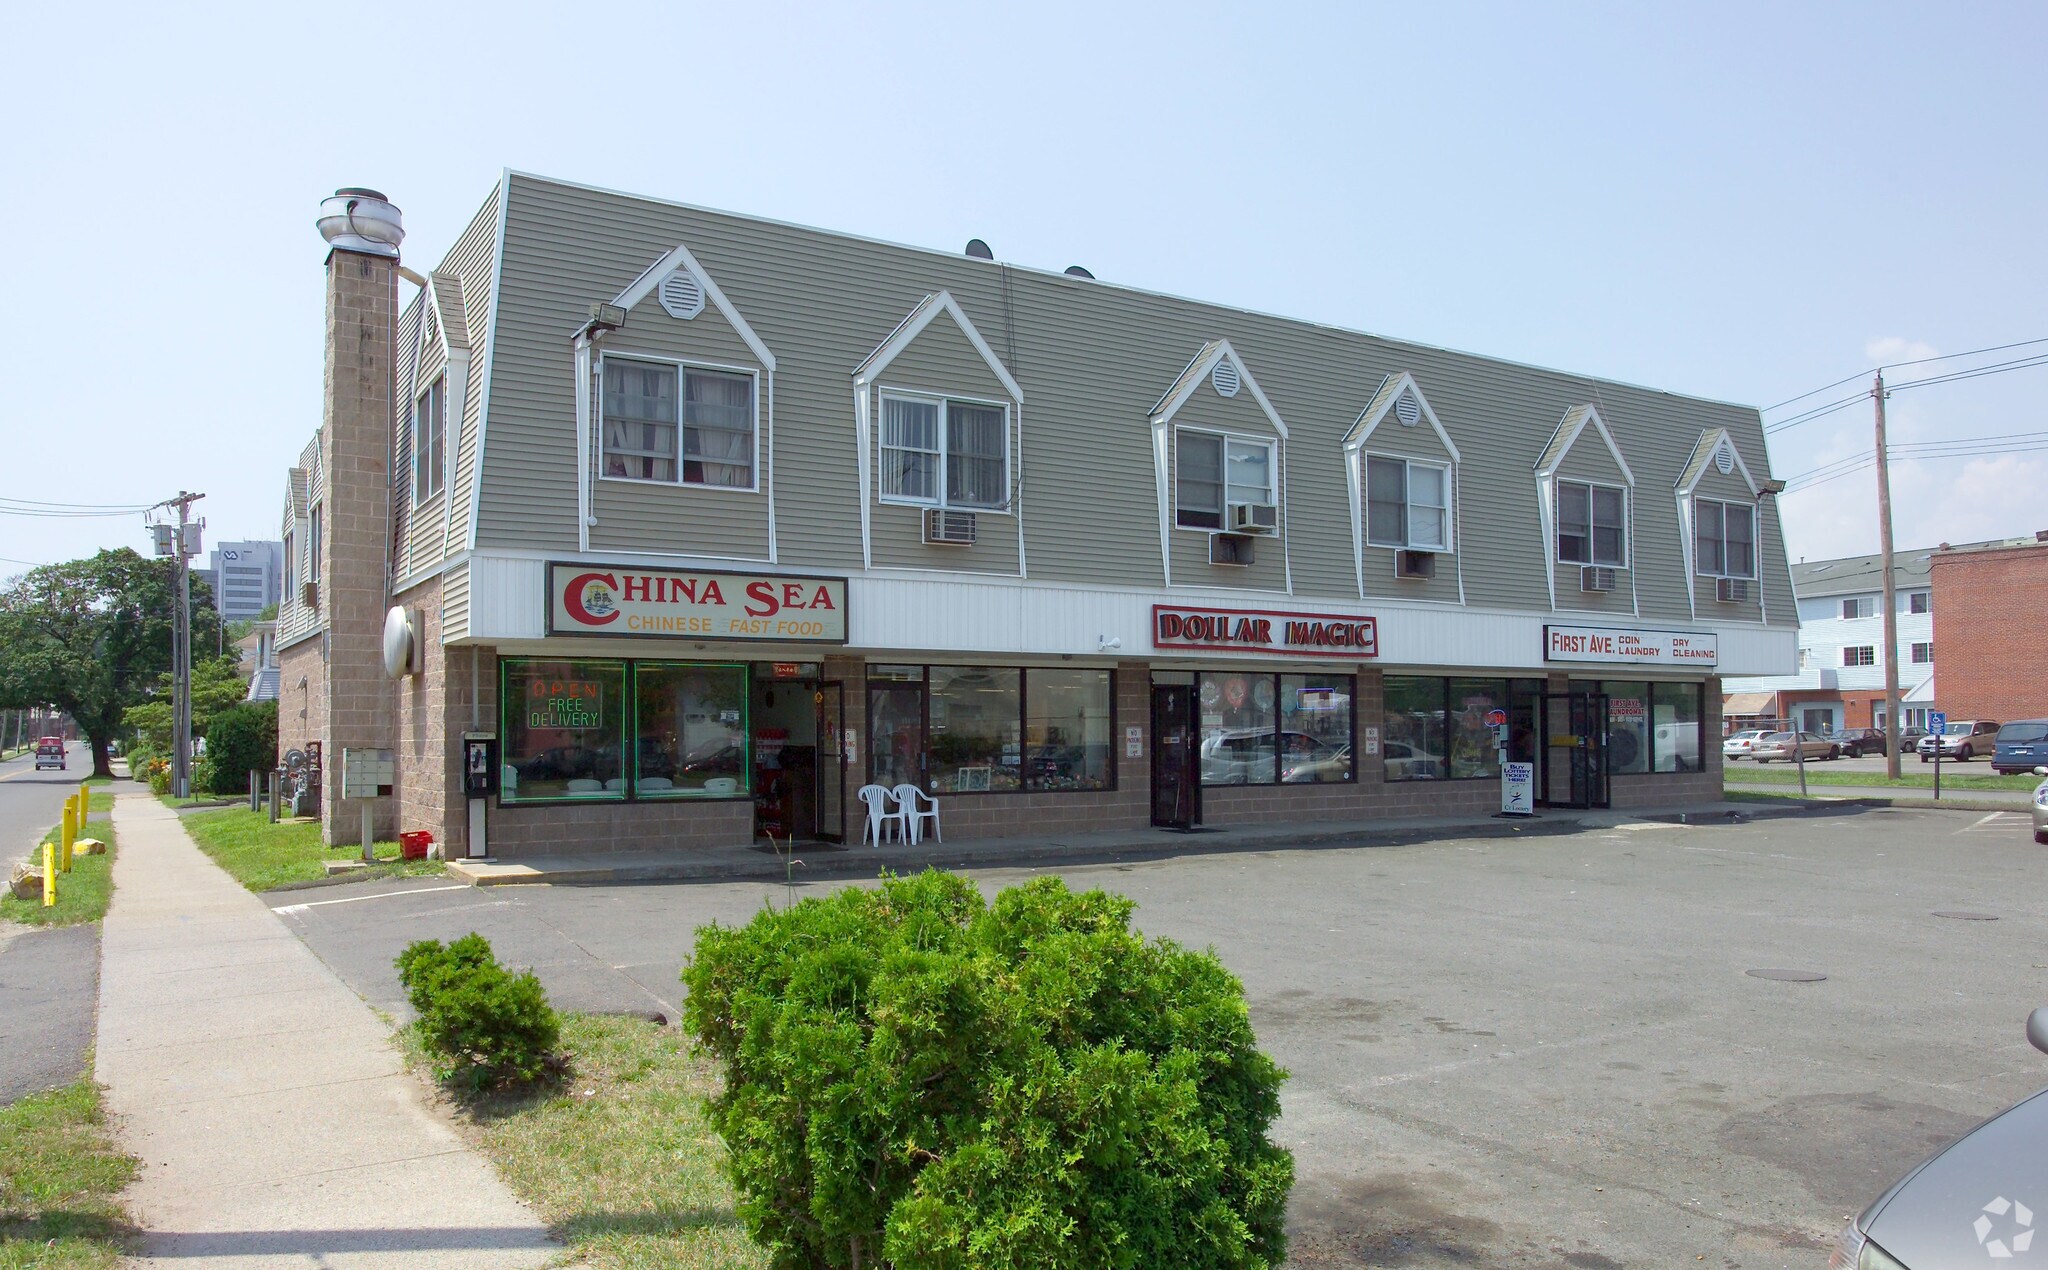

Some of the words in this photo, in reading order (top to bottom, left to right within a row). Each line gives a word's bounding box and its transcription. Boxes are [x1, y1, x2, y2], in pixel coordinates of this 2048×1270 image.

[563, 572, 727, 626] CHINA
[744, 581, 836, 618] SEA
[627, 615, 712, 632] CHINESE
[729, 619, 772, 634] FAST
[776, 621, 823, 636] FOOD
[1160, 614, 1273, 644] DOLLAR
[1284, 621, 1374, 647] MAGIC
[1552, 632, 1586, 653] FIRST
[1589, 634, 1615, 654] AVE.
[1618, 635, 1640, 645] COIN
[1672, 638, 1690, 647] DRY
[1618, 647, 1661, 656] LAUNDRY
[1672, 649, 1715, 659] CLEANING
[532, 679, 597, 698] OPEN
[548, 698, 582, 712] FREE
[1608, 708, 1645, 716] AUNDROMAT
[531, 712, 598, 727] DELIVERY
